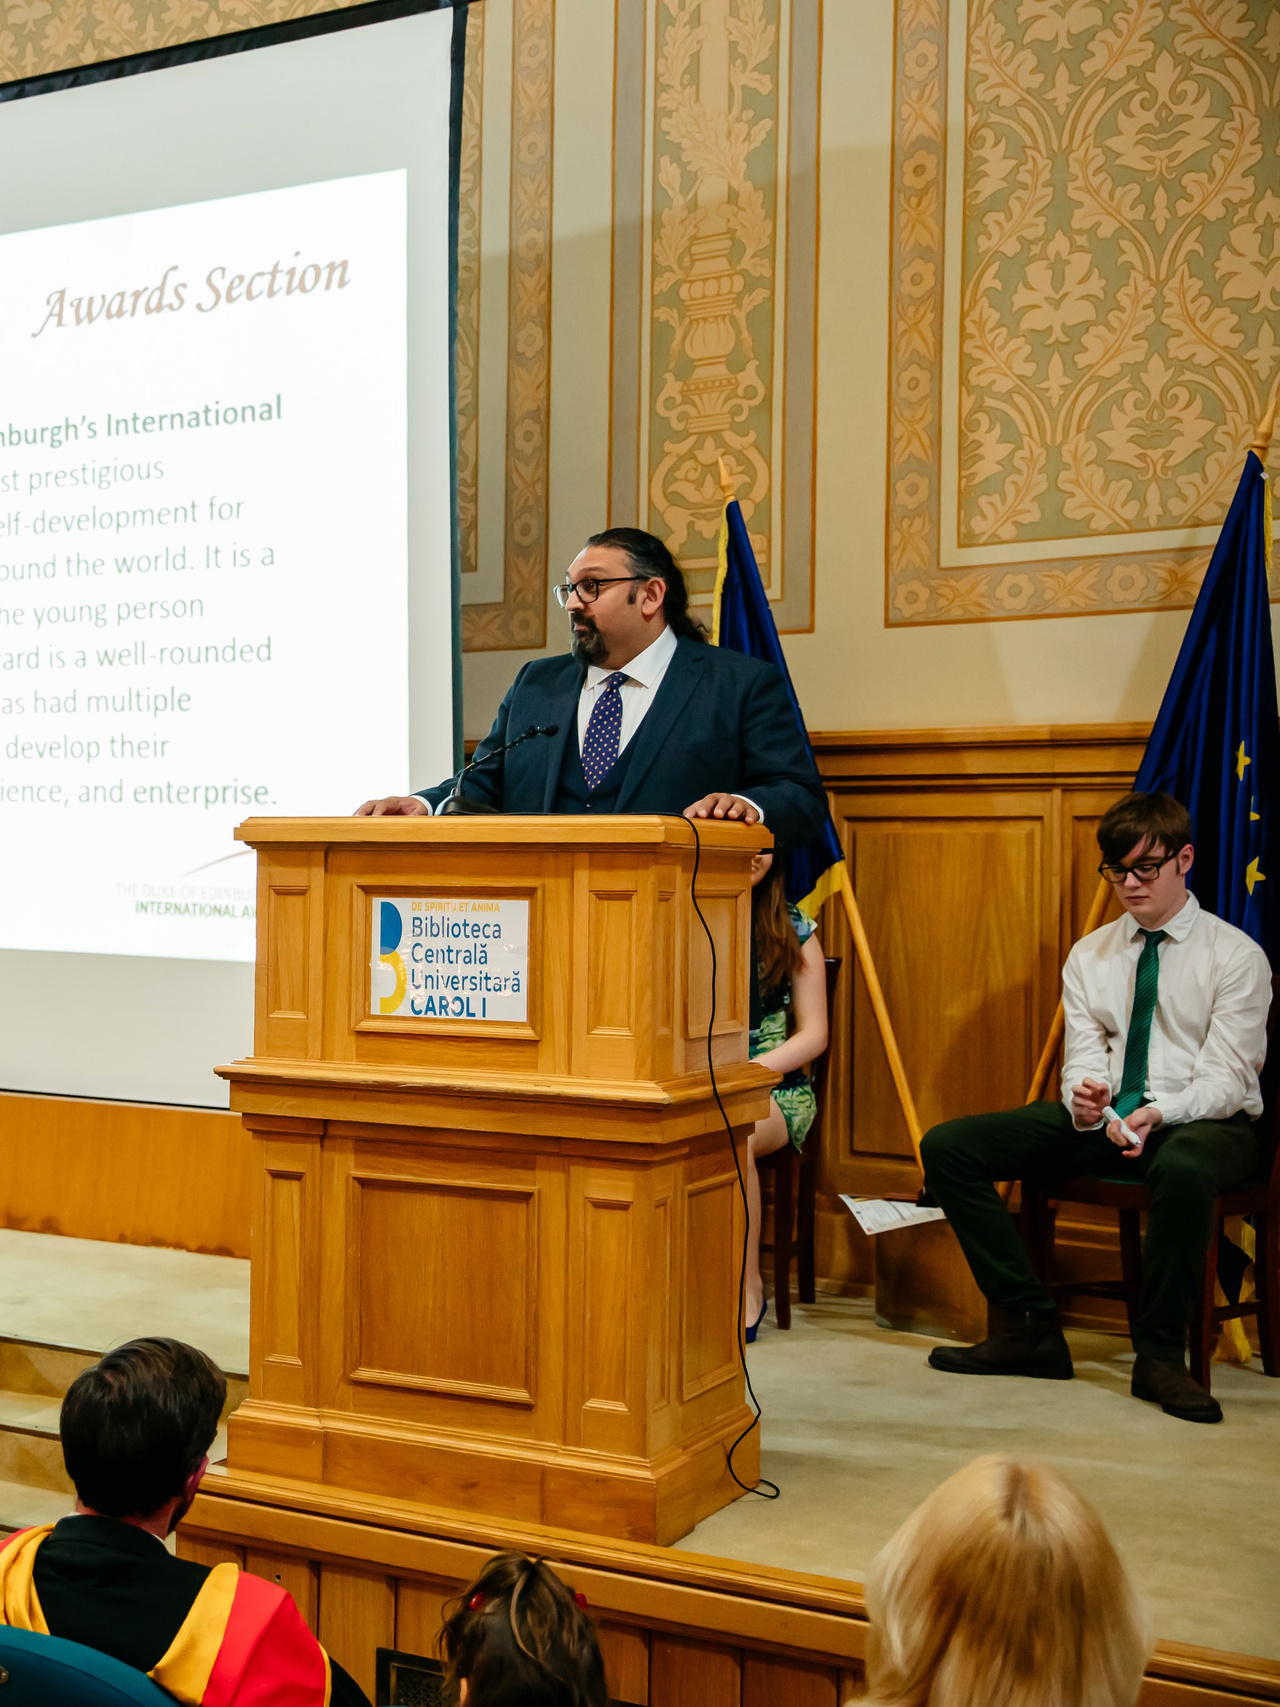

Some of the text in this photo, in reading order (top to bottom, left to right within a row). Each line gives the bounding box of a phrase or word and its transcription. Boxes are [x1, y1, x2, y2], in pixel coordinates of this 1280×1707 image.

[31, 251, 351, 338] Awards Section
[107, 393, 282, 437] International
[29, 458, 164, 496] prestigious
[208, 496, 245, 521] for
[65, 552, 105, 577] the
[114, 545, 194, 574] world.
[206, 545, 222, 569] It
[233, 542, 250, 568] is
[261, 547, 274, 566] a
[33, 603, 108, 630] young
[117, 599, 203, 627] person
[49, 644, 66, 669] is
[74, 650, 86, 668] a
[96, 636, 271, 667] well-rounded
[34, 688, 77, 714] had
[87, 686, 191, 718] multiple
[6, 734, 100, 764] develop
[109, 733, 170, 758] their
[78, 778, 123, 803] and
[133, 778, 277, 811] enterprise.
[116, 883, 137, 897] THE
[142, 884, 177, 899] DUKE
[180, 885, 196, 899] OF
[411, 901, 500, 912] DE SPIRITU ET ANIMA
[135, 901, 238, 918] INTERNATIONAL
[412, 916, 502, 939] Biblioteca
[411, 942, 488, 965] Centrală
[411, 968, 521, 993] Universitară
[410, 995, 487, 1018] CAROL I
